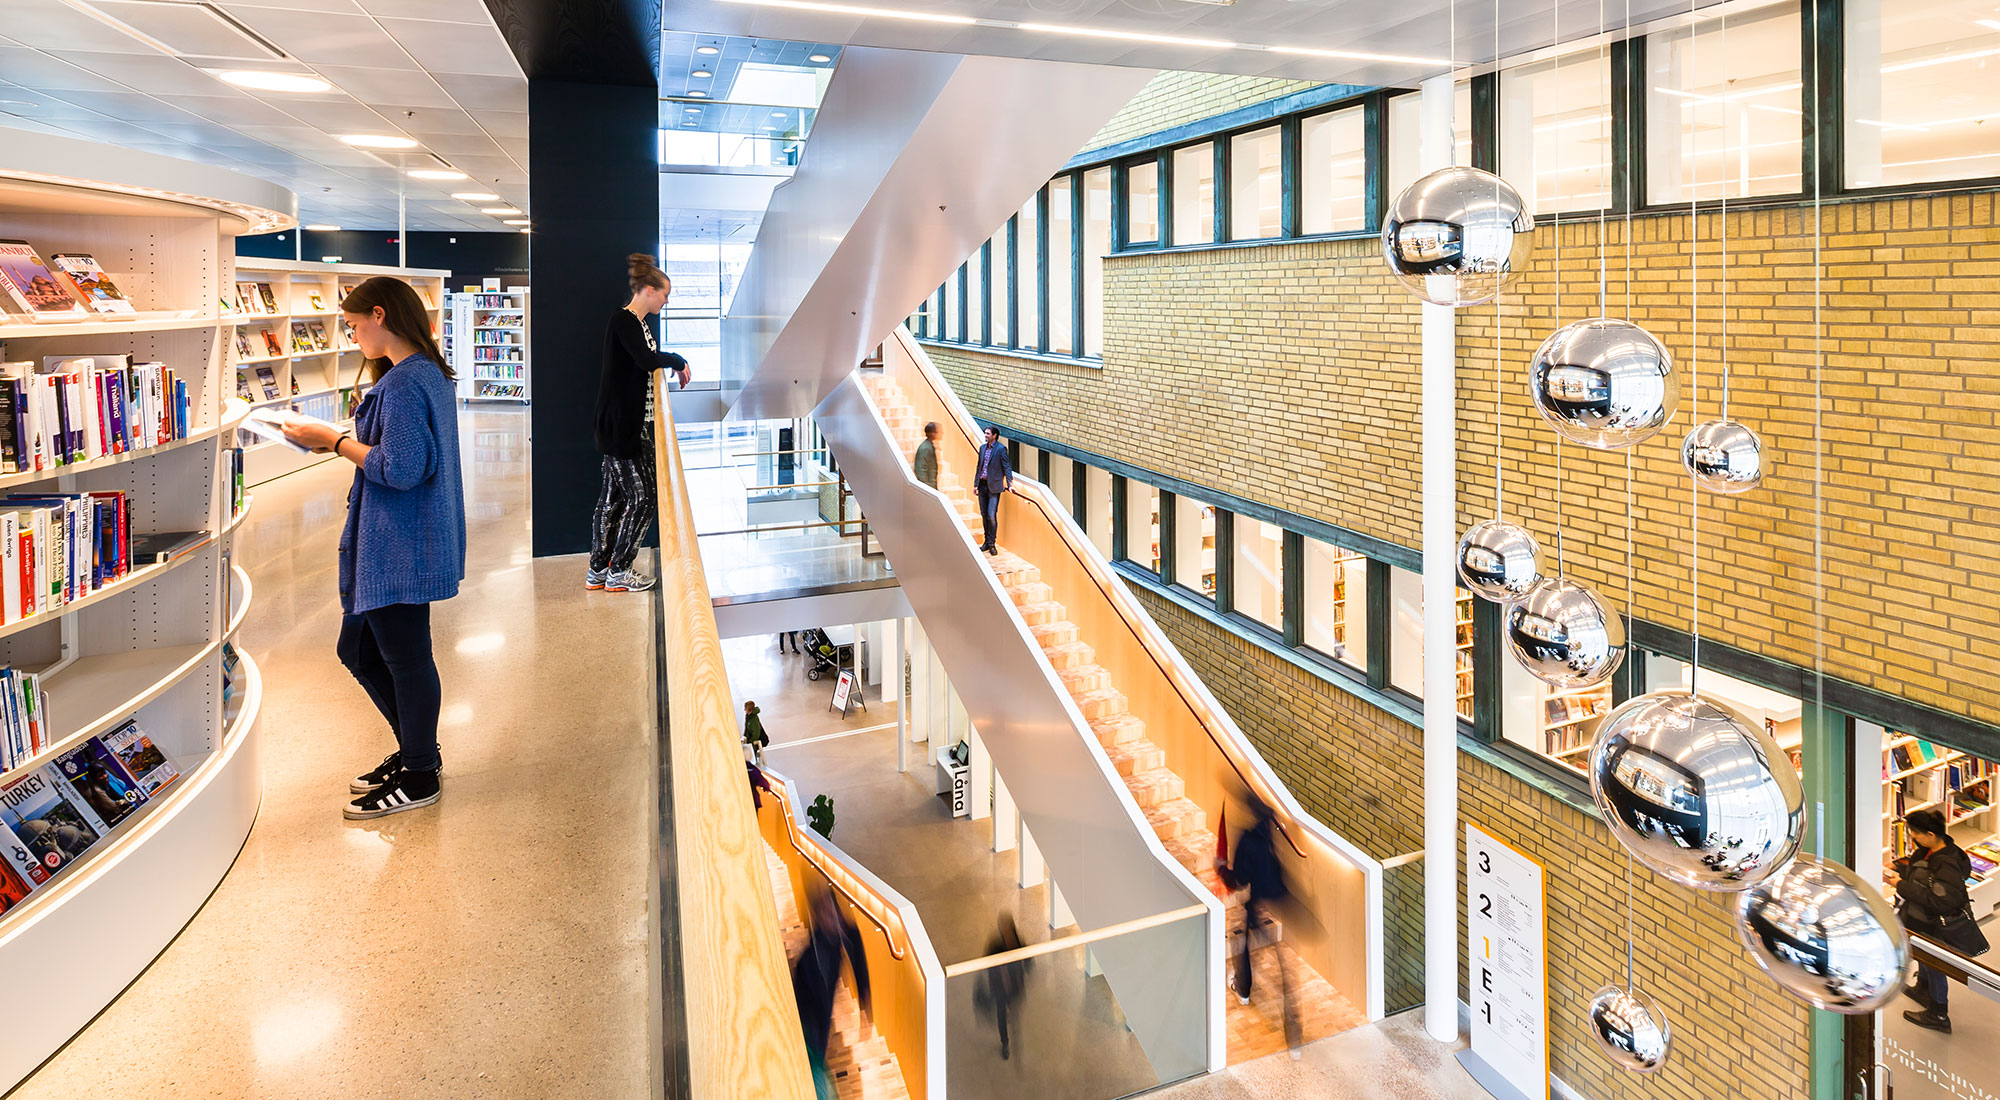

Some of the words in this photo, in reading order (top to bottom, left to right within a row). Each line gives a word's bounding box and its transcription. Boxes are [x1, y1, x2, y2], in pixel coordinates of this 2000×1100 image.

[111, 384, 120, 418] Thailand
[113, 730, 127, 743] TOP
[126, 725, 137, 735] 10
[55, 741, 89, 764] Bangladesh
[0, 773, 46, 810] TURKEY
[954, 770, 968, 812] Låna
[1478, 850, 1491, 874] 3
[1479, 893, 1493, 919] 2
[1482, 935, 1490, 960] 1
[1482, 966, 1493, 994] E
[1480, 1000, 1492, 1025] -1
